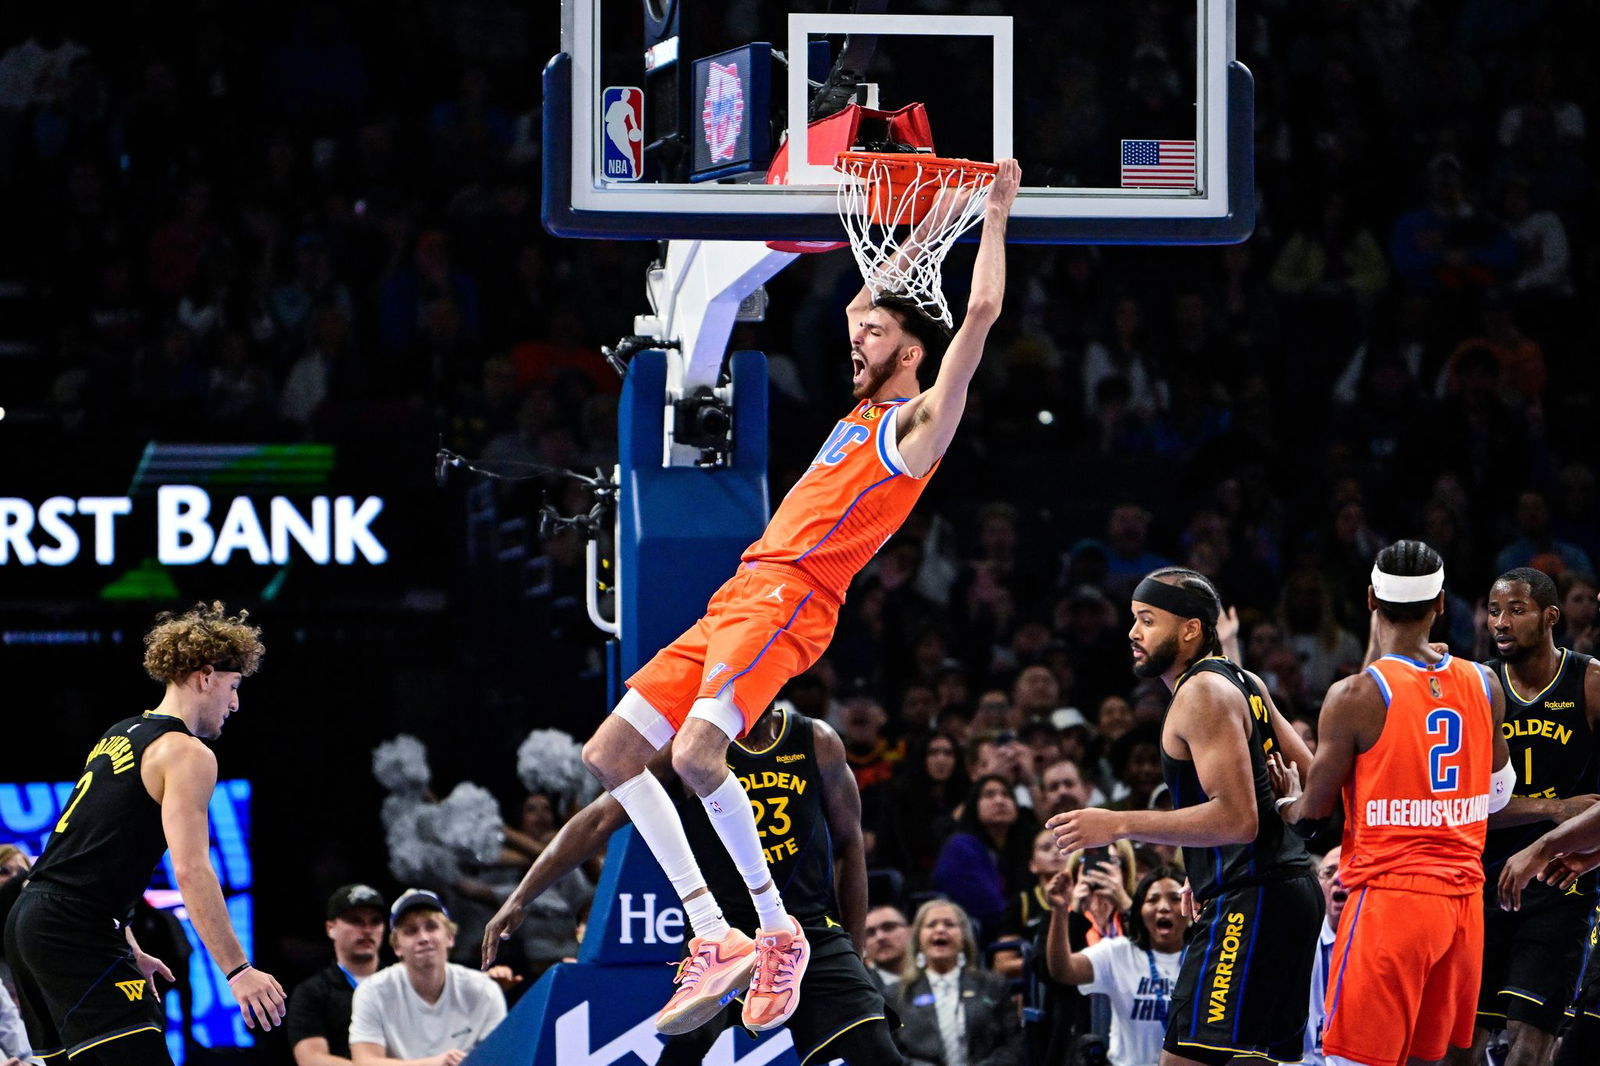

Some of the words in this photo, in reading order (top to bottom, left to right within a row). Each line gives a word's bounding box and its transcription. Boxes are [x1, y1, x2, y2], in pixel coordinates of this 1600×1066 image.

[608, 159, 628, 174] NBA
[157, 484, 388, 565] BANK
[1544, 701, 1575, 711] Rakuten
[1501, 718, 1573, 745] OLDEN
[775, 753, 806, 764] Rakuten
[1426, 707, 1463, 793] 2
[1524, 746, 1533, 785] 1
[738, 771, 807, 795] OLDEN
[55, 770, 94, 833] 2
[749, 796, 792, 838] 23
[762, 837, 799, 864] ATE
[1207, 912, 1245, 1023] WARRIORS
